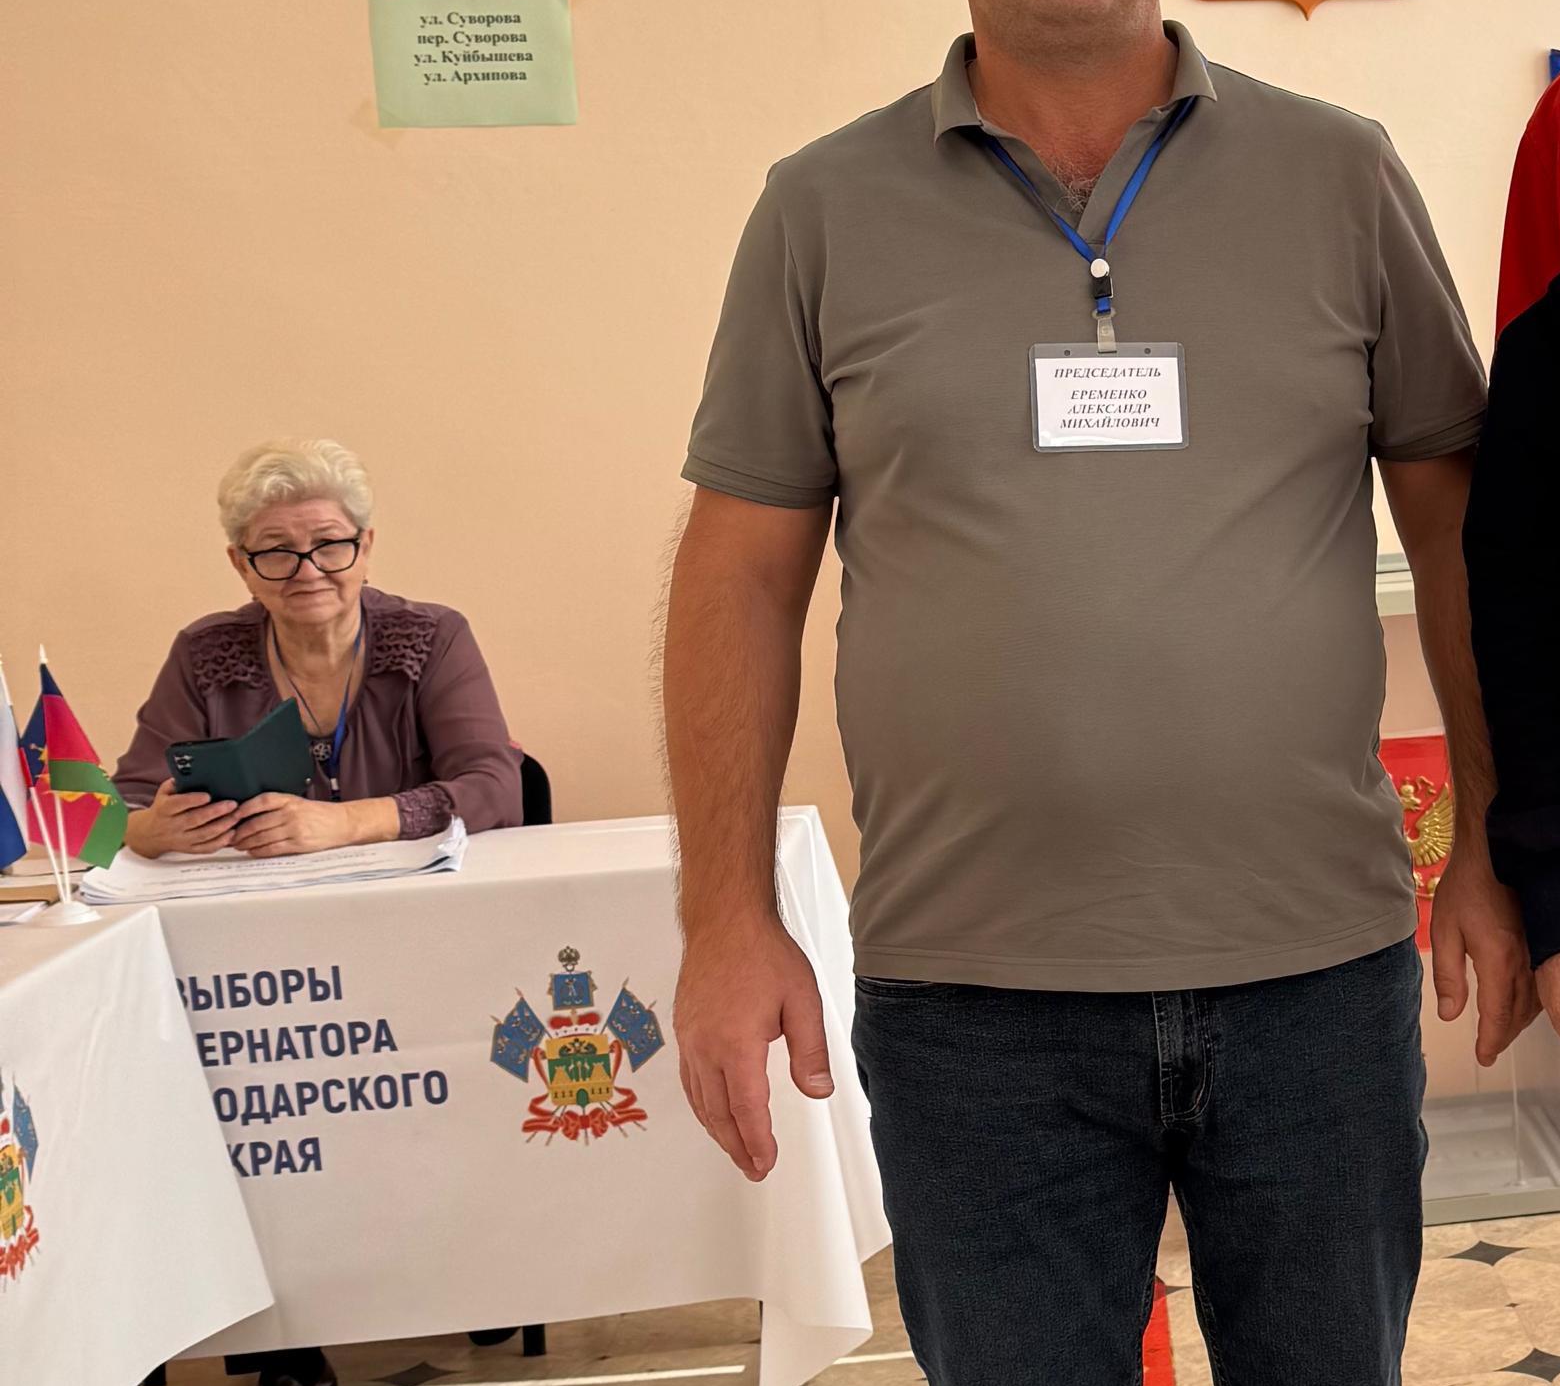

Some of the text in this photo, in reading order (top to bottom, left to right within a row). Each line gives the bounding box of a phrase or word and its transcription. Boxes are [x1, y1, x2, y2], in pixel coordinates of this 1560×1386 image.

[420, 11, 521, 28] ул. Суворова
[417, 31, 528, 47] пер. Суворова
[414, 50, 534, 66] ул. Куйбышева
[423, 69, 528, 85] ул. Архипова
[1054, 367, 1162, 380] ПРЕДСЕДАТЕЛЬ
[1071, 389, 1147, 401] ЕРЕМЕНКО
[1067, 403, 1151, 415] АЛЕКСАНДР
[1060, 416, 1160, 429] МИХАЙЛОВИЧ
[196, 1018, 398, 1067] ЕРНАТОРА
[213, 1070, 449, 1126] ОДАРСКОГО
